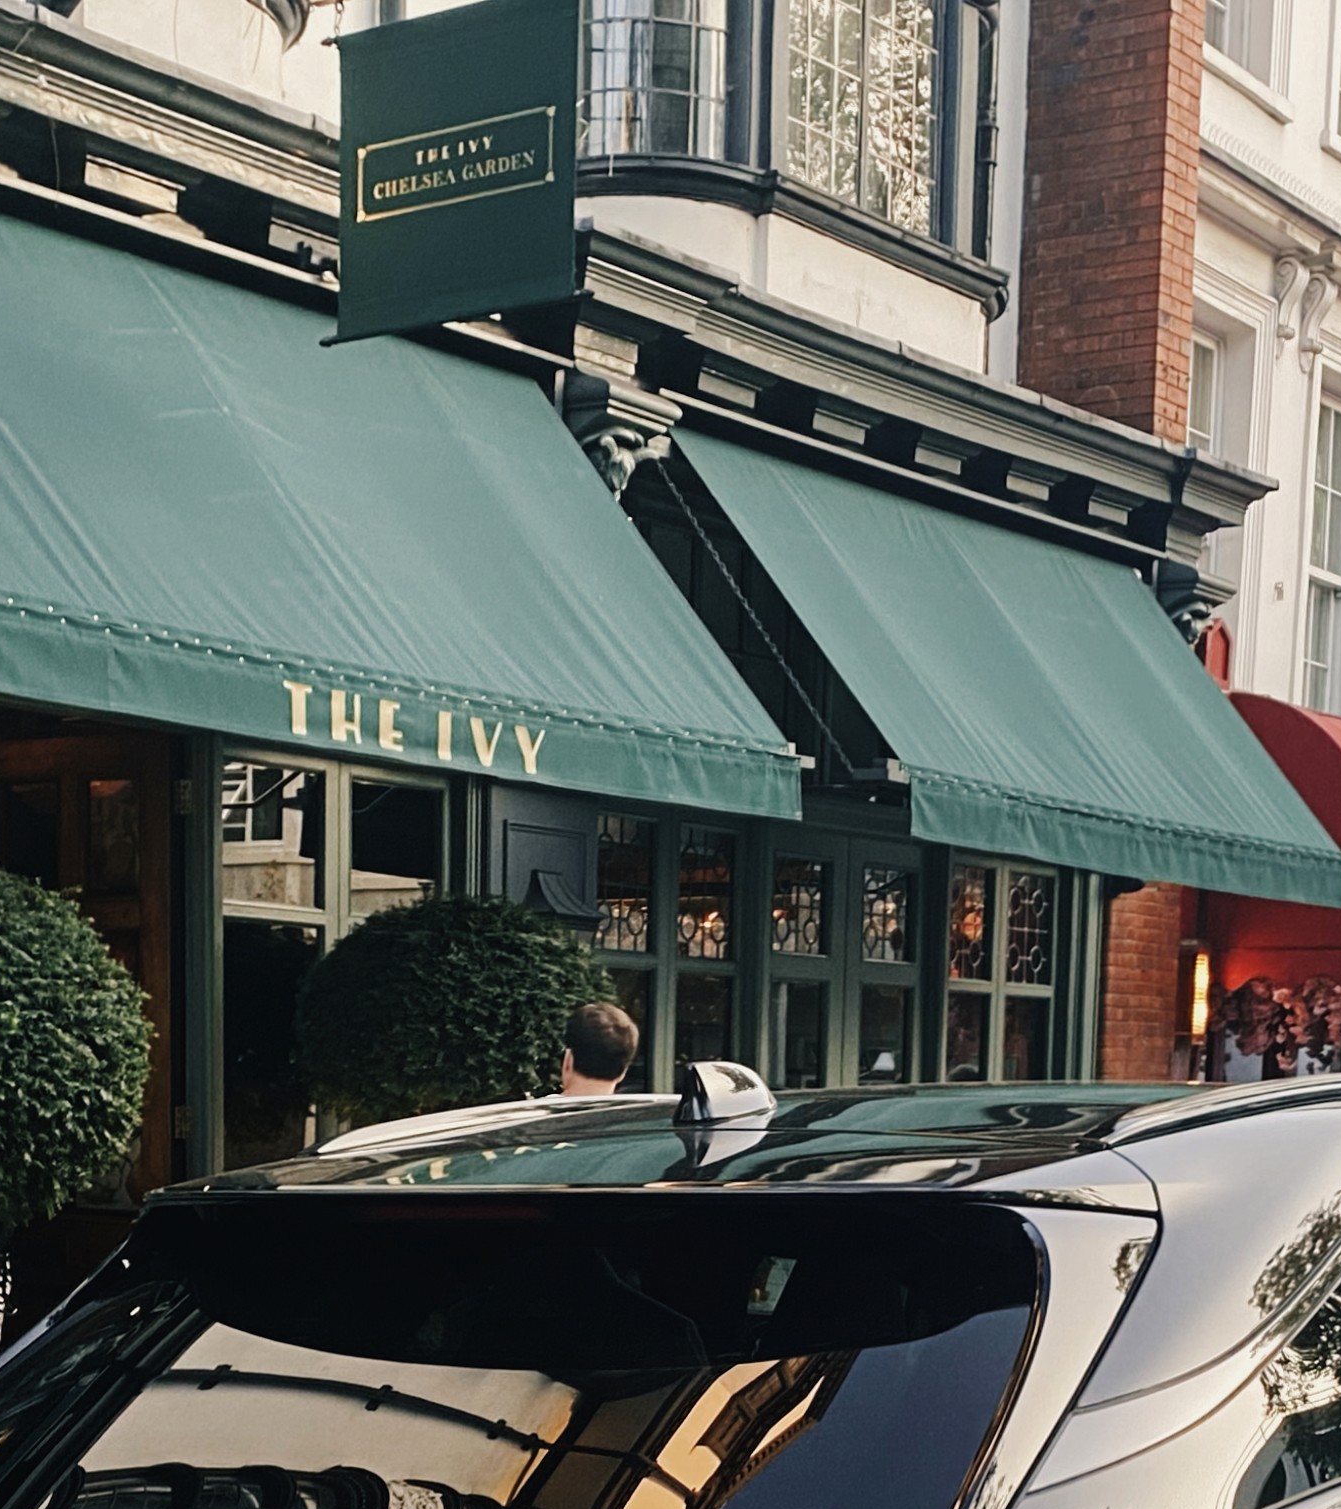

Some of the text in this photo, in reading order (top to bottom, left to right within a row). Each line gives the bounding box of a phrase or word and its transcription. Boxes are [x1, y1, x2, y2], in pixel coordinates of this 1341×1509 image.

[373, 150, 535, 199] CHELSEA GARDEN
[415, 135, 493, 165] THE IVY
[283, 680, 546, 774] THE IVY
